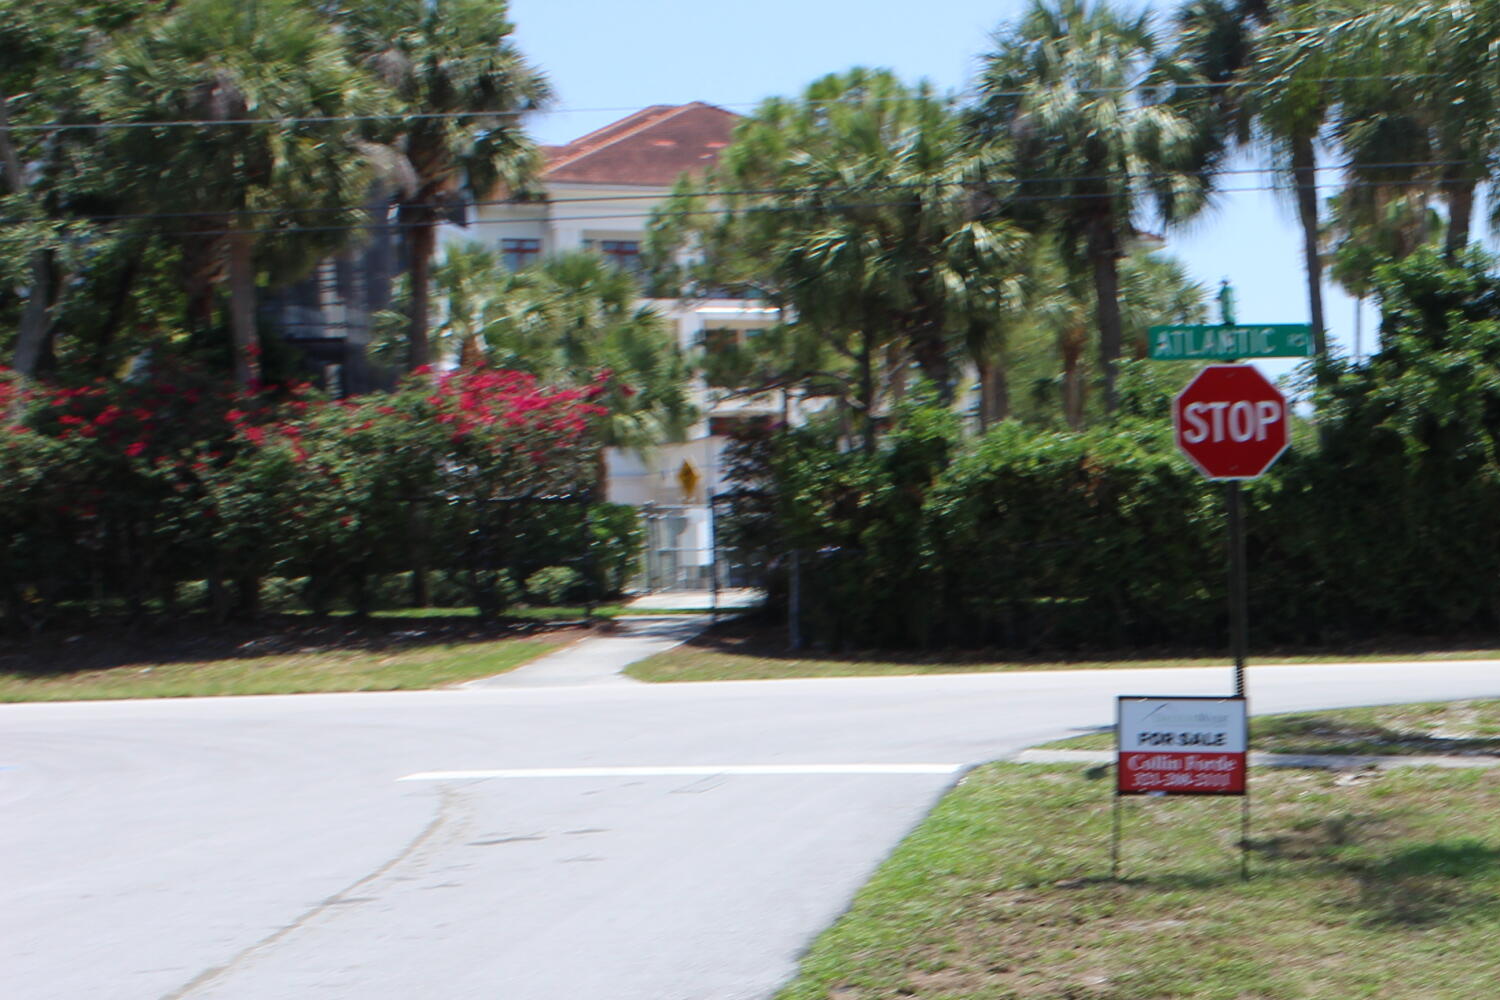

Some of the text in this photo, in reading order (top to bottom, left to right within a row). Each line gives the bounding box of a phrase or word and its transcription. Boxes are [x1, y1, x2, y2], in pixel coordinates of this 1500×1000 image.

[1154, 328, 1276, 357] ATLANTIC
[1182, 400, 1282, 444] STOP
[1137, 732, 1228, 746] FOR SALE
[1127, 754, 1183, 771] Collin
